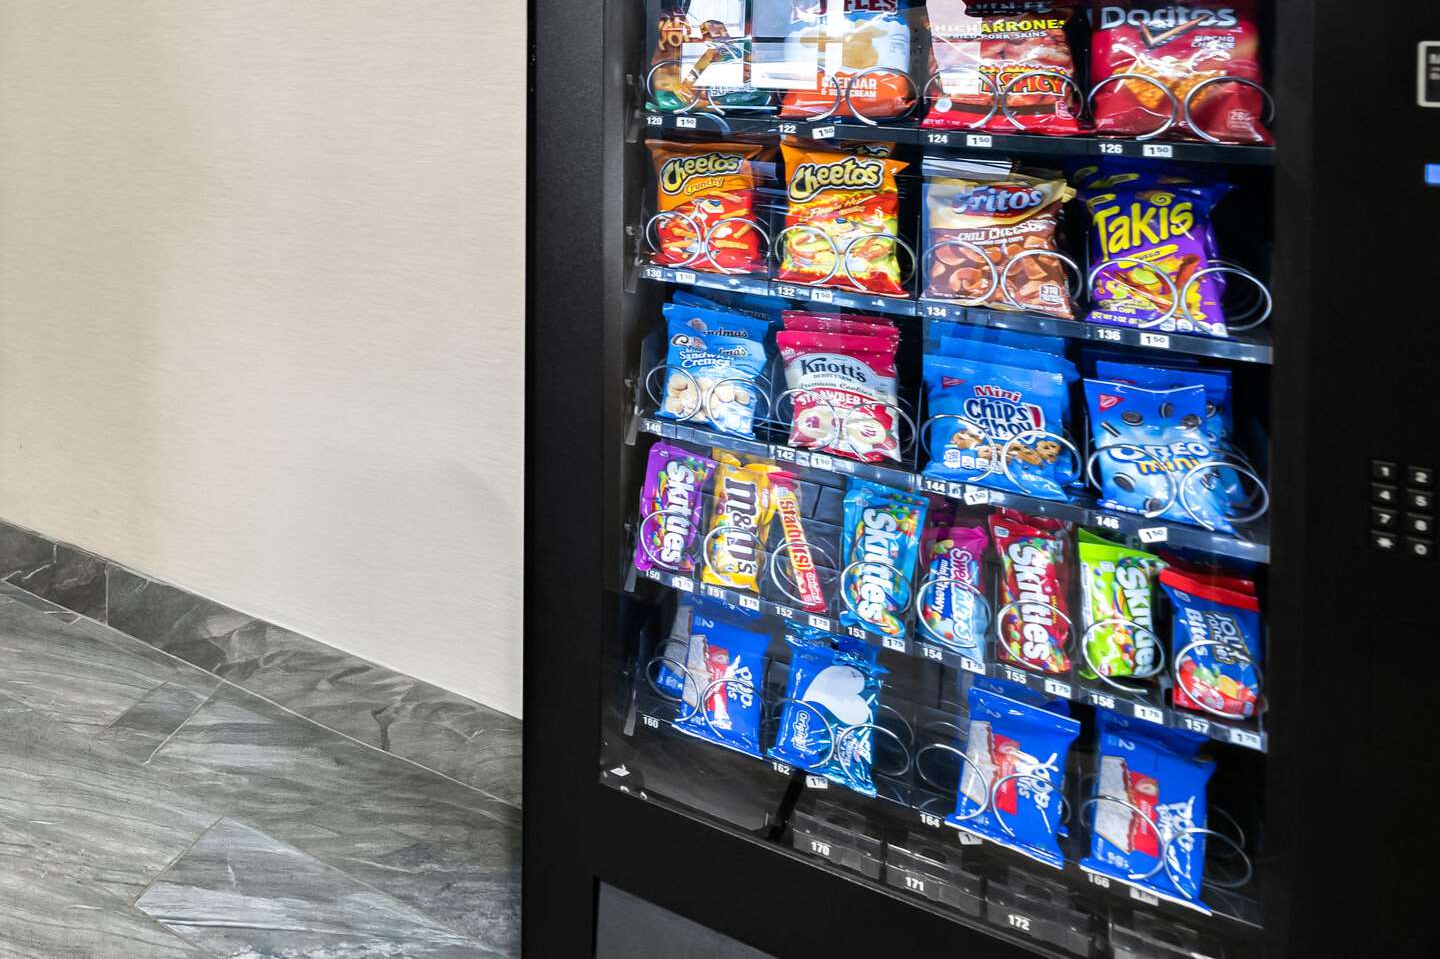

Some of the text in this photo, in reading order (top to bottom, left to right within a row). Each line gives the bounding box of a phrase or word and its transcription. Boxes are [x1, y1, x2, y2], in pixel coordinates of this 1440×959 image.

[1100, 5, 1238, 30] Doritos
[1013, 30, 1048, 39] SKINS
[778, 124, 796, 134] 122
[927, 134, 948, 144] 124
[1098, 143, 1123, 154] 126
[660, 153, 742, 193] Cheetos
[789, 158, 883, 200] Cheetos
[953, 185, 1044, 214] Fritos
[1093, 193, 1194, 263] Takis
[957, 230, 985, 242] CHILI
[776, 286, 796, 296] 132
[926, 306, 947, 318] 134
[800, 357, 867, 383] Knott's
[974, 385, 1022, 402] Mini
[965, 398, 1029, 422] Chips
[776, 449, 795, 460] 142
[1108, 442, 1210, 461] OREO
[1137, 456, 1202, 475] mini
[925, 481, 946, 492] 144
[775, 606, 793, 618] 152
[847, 626, 867, 640] 153
[923, 648, 943, 661] 154
[1005, 670, 1027, 684] 155
[792, 710, 809, 754] Original
[1184, 717, 1210, 733] 157
[772, 761, 790, 776] 162
[904, 876, 925, 892] 171
[1007, 914, 1030, 931] 172
